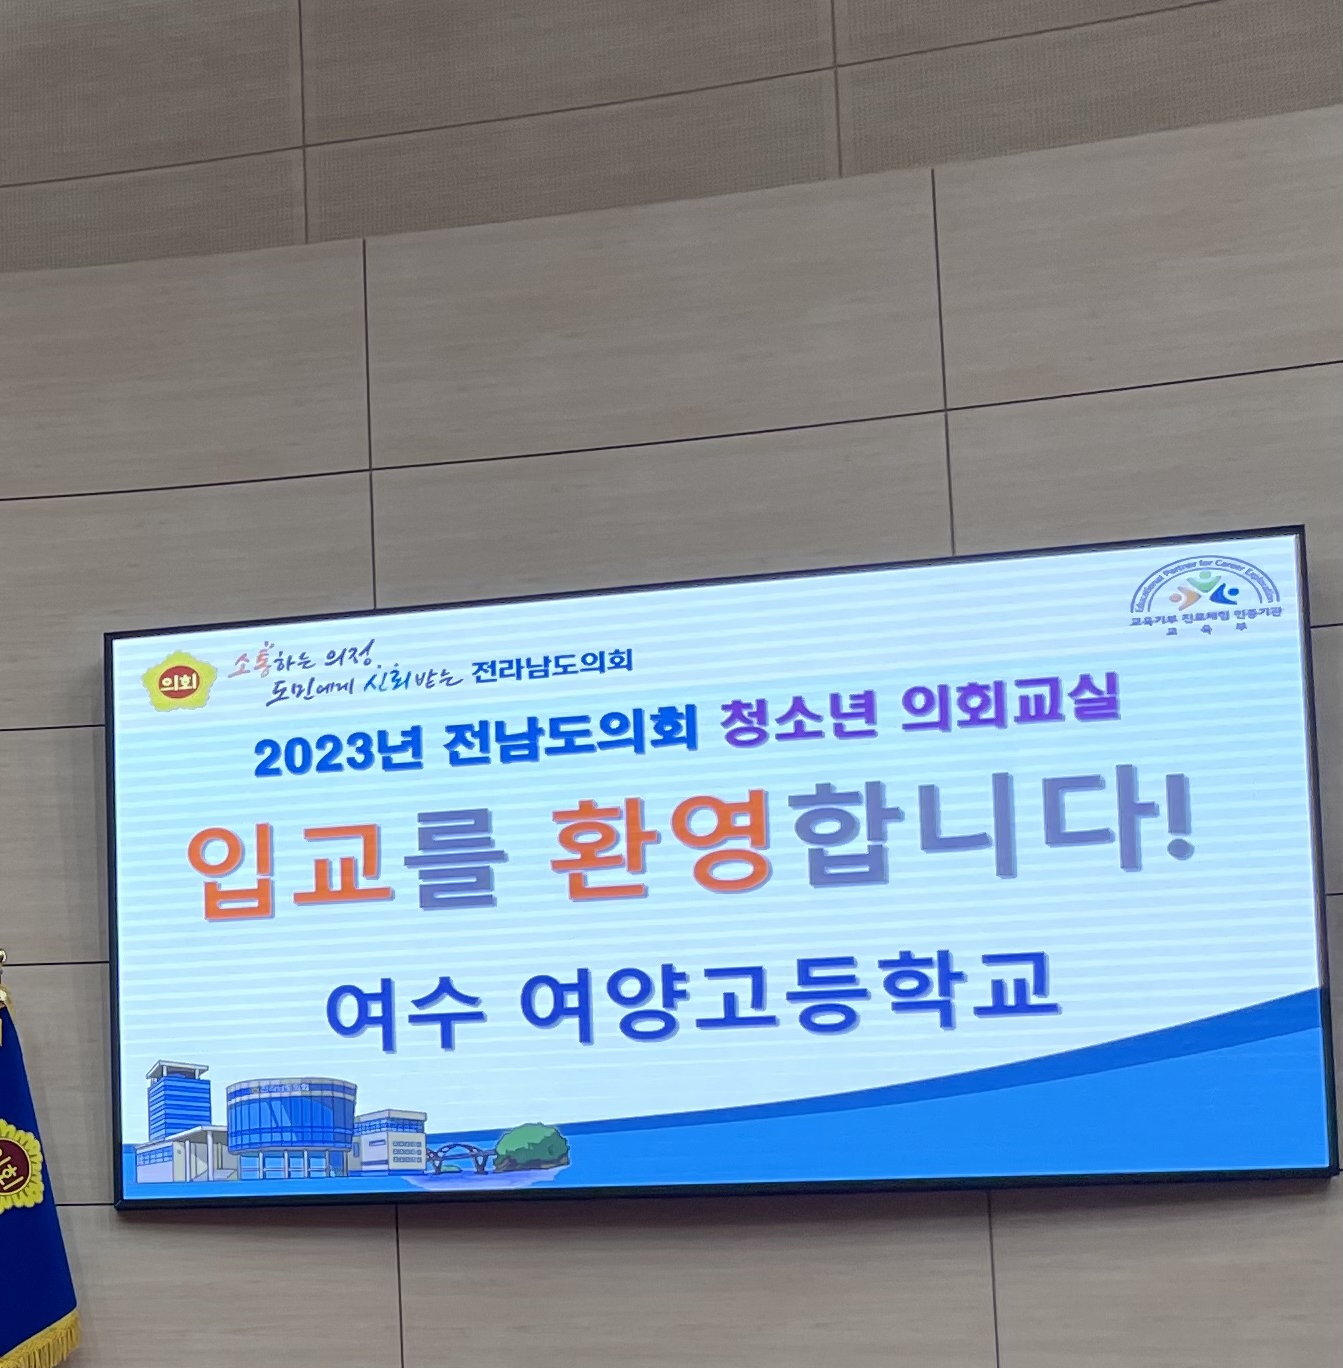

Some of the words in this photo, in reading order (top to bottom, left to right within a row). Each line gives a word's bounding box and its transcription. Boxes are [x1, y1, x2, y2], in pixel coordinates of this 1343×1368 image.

[159, 672, 198, 693] 의회
[227, 640, 316, 679] 소통하는
[324, 638, 376, 667] 의정
[265, 676, 355, 708] 도민에게
[362, 662, 464, 693] 신뢰받는
[471, 647, 634, 685] 전라남도의회
[253, 723, 425, 779] 2023년
[443, 702, 699, 768] 전남도의회
[719, 689, 879, 750] 청소년
[900, 670, 1123, 733] 의회교실
[186, 806, 509, 923] 입교를
[549, 764, 1195, 902] 환영합니다!
[325, 975, 487, 1055] 여수
[519, 949, 1063, 1046] 여양고등학교
